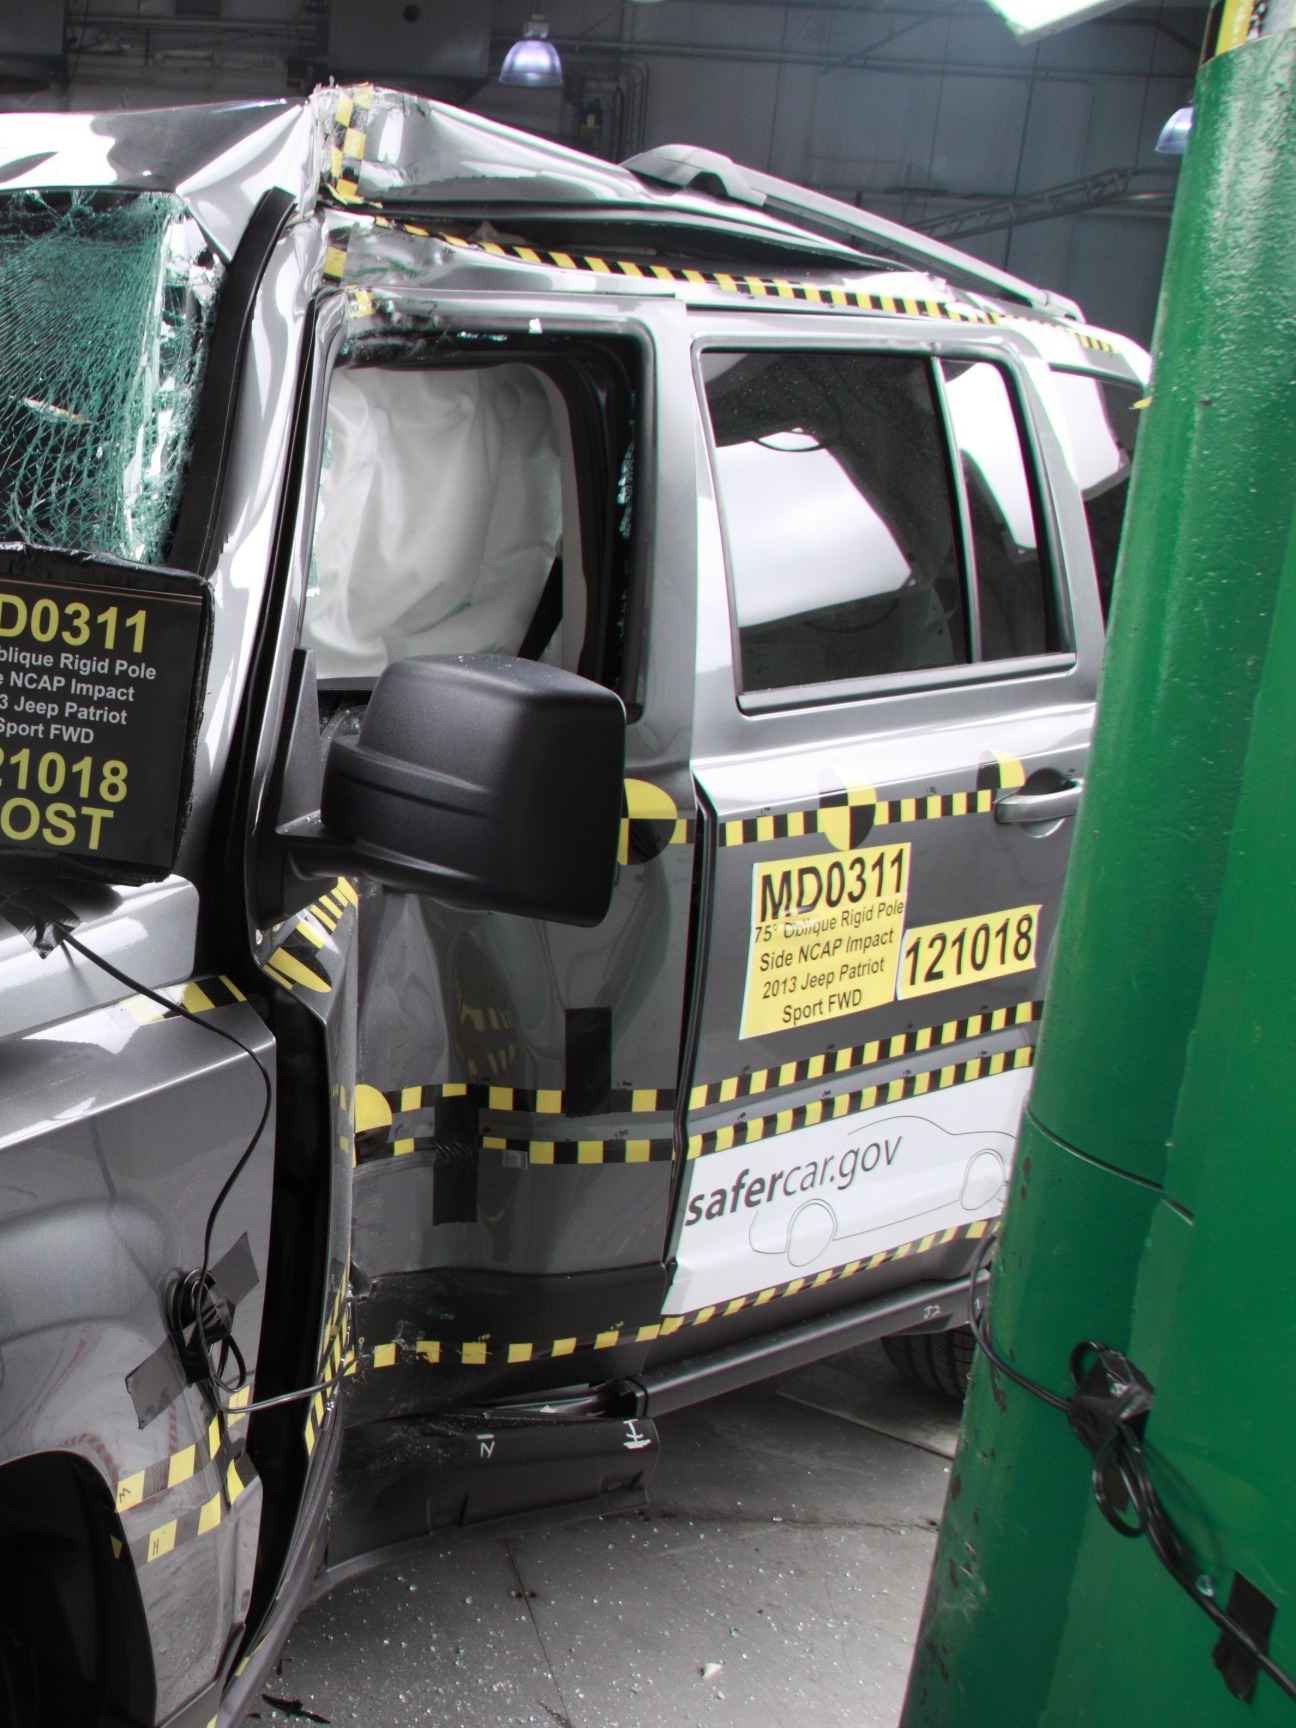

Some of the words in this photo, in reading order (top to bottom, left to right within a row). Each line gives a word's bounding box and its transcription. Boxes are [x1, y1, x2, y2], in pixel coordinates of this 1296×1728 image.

[10, 671, 65, 692] NCAP
[71, 678, 135, 702] Impact
[60, 653, 109, 675] Rigid
[115, 660, 157, 680] Pole
[14, 696, 59, 720] Jeep
[65, 702, 127, 725] Patriot
[50, 724, 95, 744] FWD
[760, 848, 905, 923] MD0311
[754, 923, 779, 943] 75°
[784, 913, 837, 941] Oblique
[841, 907, 874, 933] Rigid
[877, 900, 905, 921] Pole
[760, 946, 793, 972] Side
[798, 937, 843, 963] NCAP
[846, 929, 894, 955] Impact
[904, 913, 1034, 986] 121018
[762, 975, 797, 1000] 2013
[801, 966, 835, 991] Jeep
[839, 957, 885, 982] Patriot
[782, 1000, 824, 1025] Sport
[827, 988, 863, 1013] FWD
[684, 1135, 902, 1227] safercar.gov
